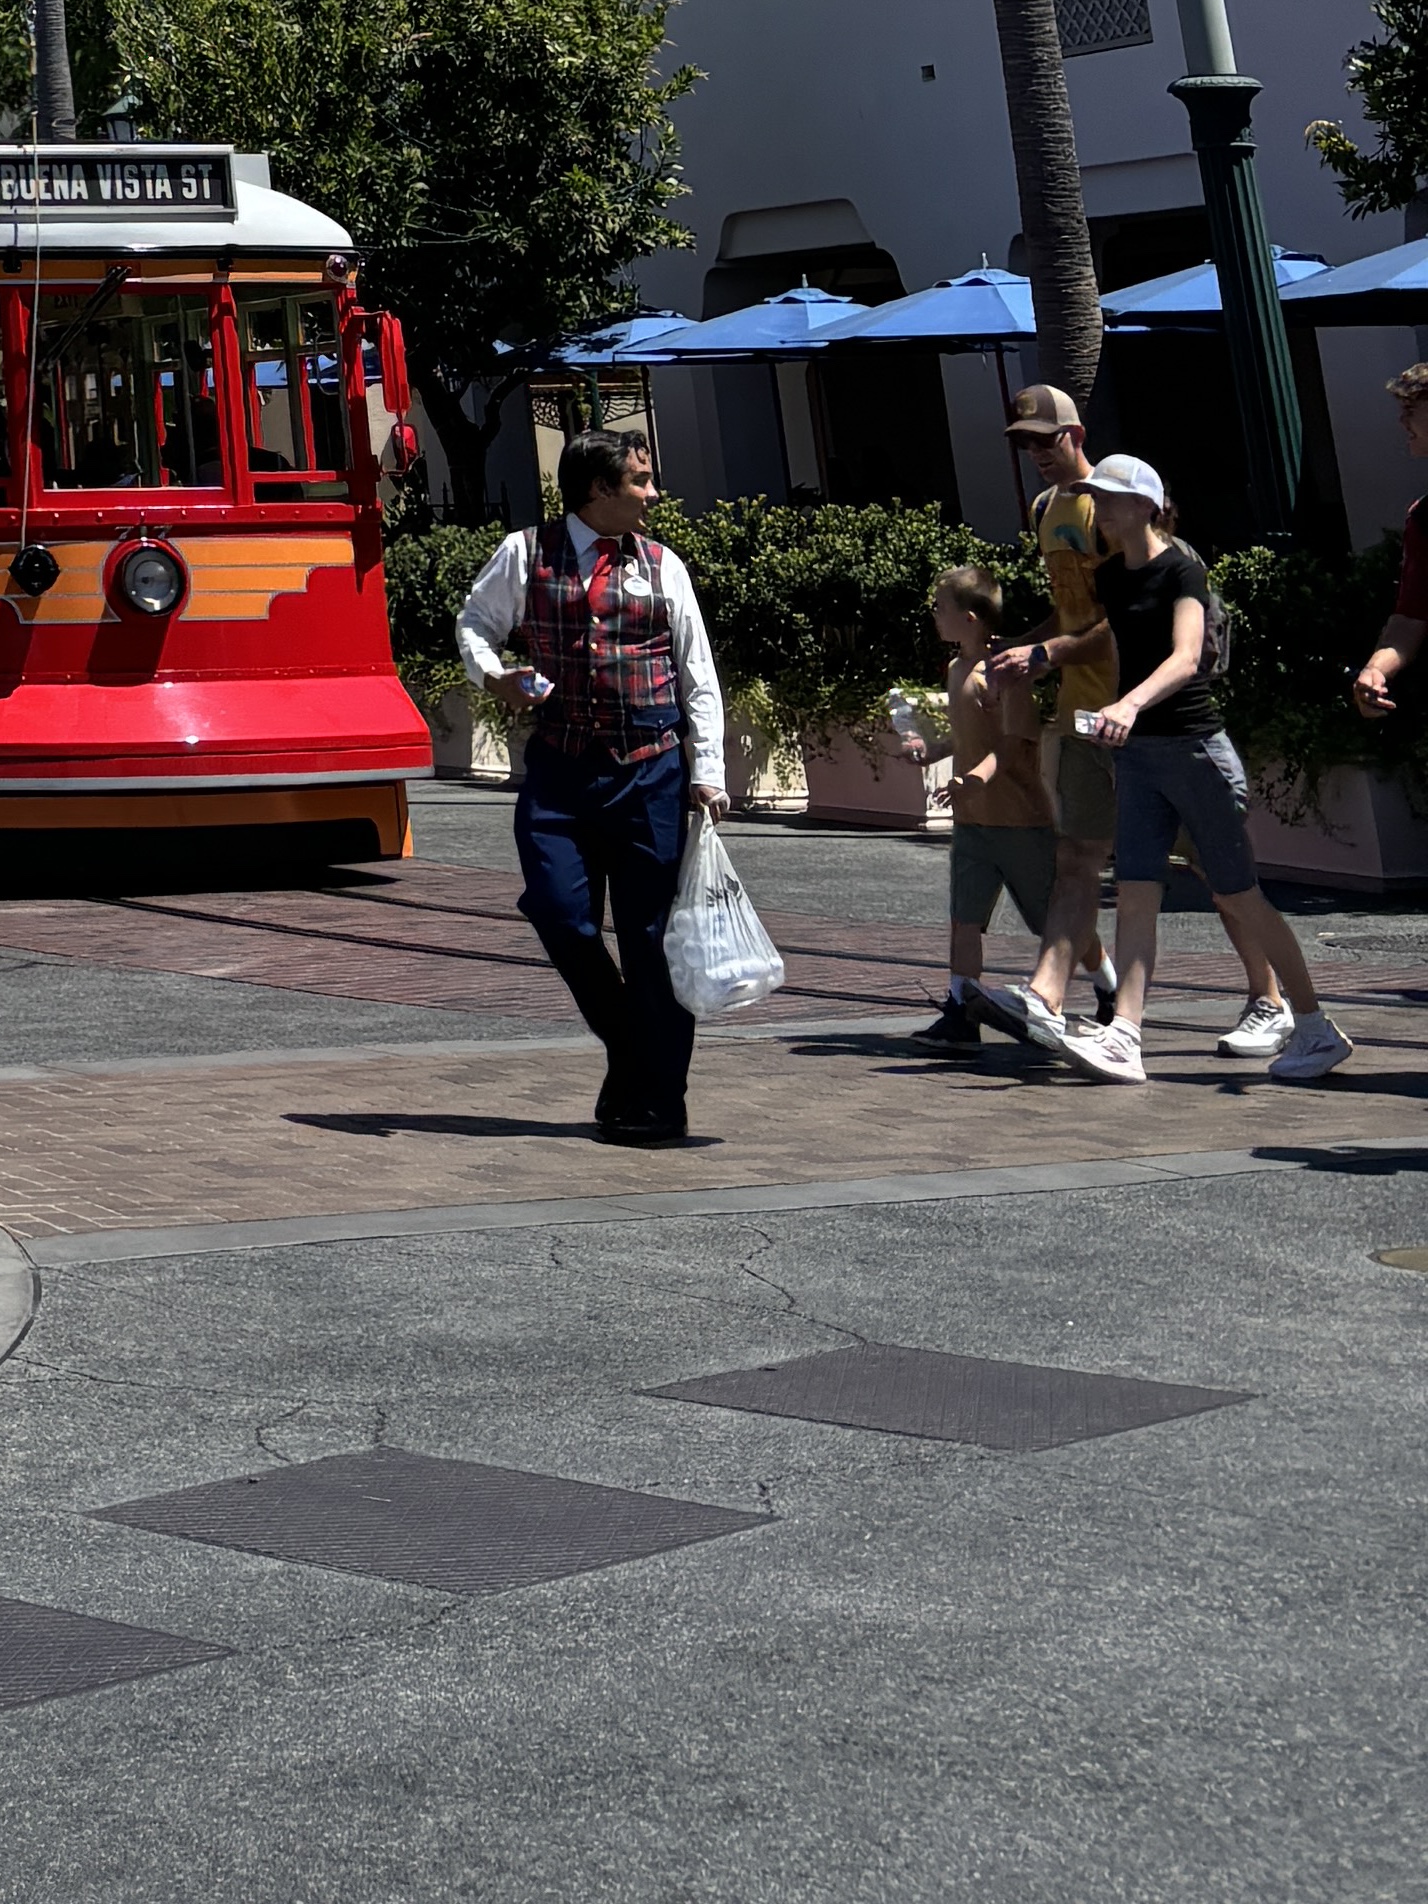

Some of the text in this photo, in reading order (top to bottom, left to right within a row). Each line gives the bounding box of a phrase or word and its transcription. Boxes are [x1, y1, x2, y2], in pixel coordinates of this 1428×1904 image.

[0, 163, 213, 200] BUENA VISTA ST
